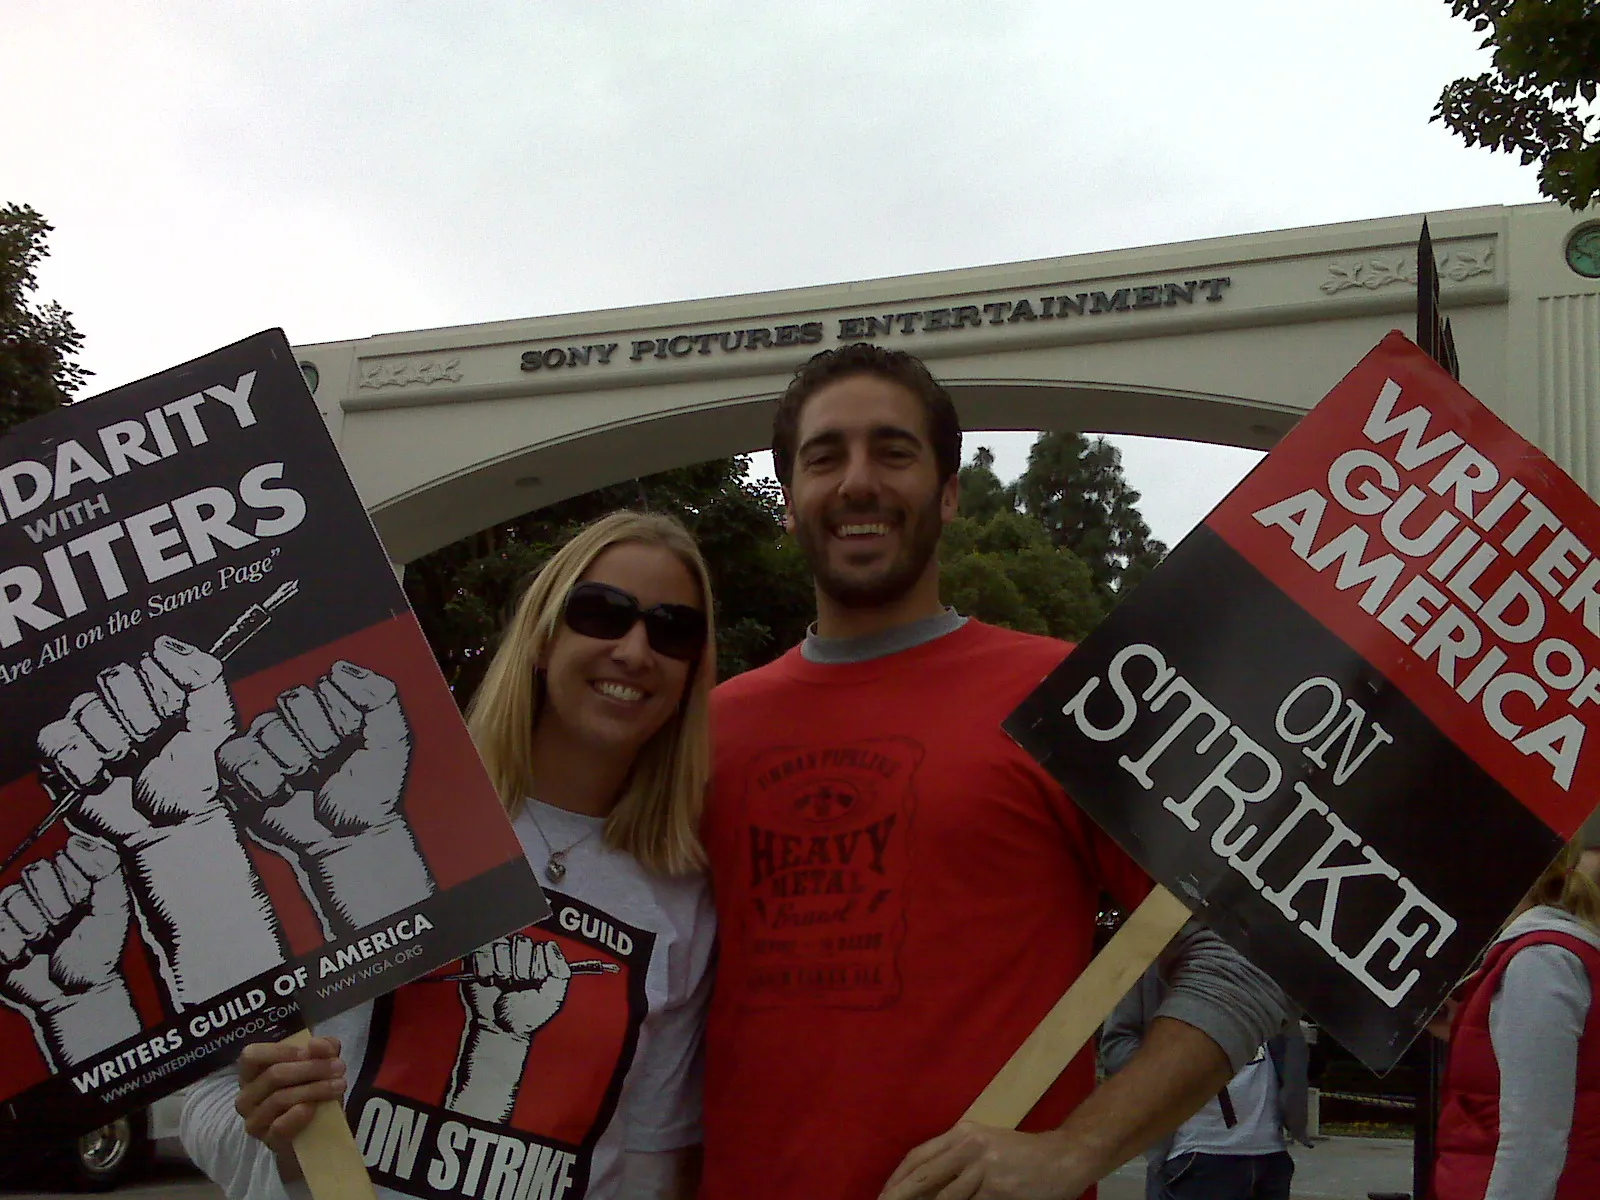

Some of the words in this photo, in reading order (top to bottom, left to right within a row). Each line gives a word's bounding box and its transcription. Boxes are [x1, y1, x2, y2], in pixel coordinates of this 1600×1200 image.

[520, 342, 618, 371] SONY
[629, 322, 823, 361] PICTURES
[836, 276, 1232, 340] ENTERTAINMENT
[0, 370, 258, 526] DARITY
[22, 492, 111, 544] WITH
[1326, 448, 1546, 644] GUILD
[0, 657, 33, 685] Are
[37, 633, 71, 669] All
[75, 624, 104, 650] on
[107, 608, 143, 636] the
[147, 579, 214, 619] Same
[1250, 486, 1586, 793] AMERICA
[1274, 675, 1394, 787] ON
[748, 812, 898, 889] HEAVY
[1061, 642, 1458, 1009] STRIKE
[559, 906, 634, 956] GUILD
[770, 868, 867, 898] METAL
[71, 1027, 184, 1095] WRITERS
[189, 988, 267, 1038] GUILD
[273, 965, 309, 997] OF
[319, 913, 435, 979] AMERICA
[356, 1096, 430, 1181] ON
[426, 1120, 577, 1200] STRIKE
